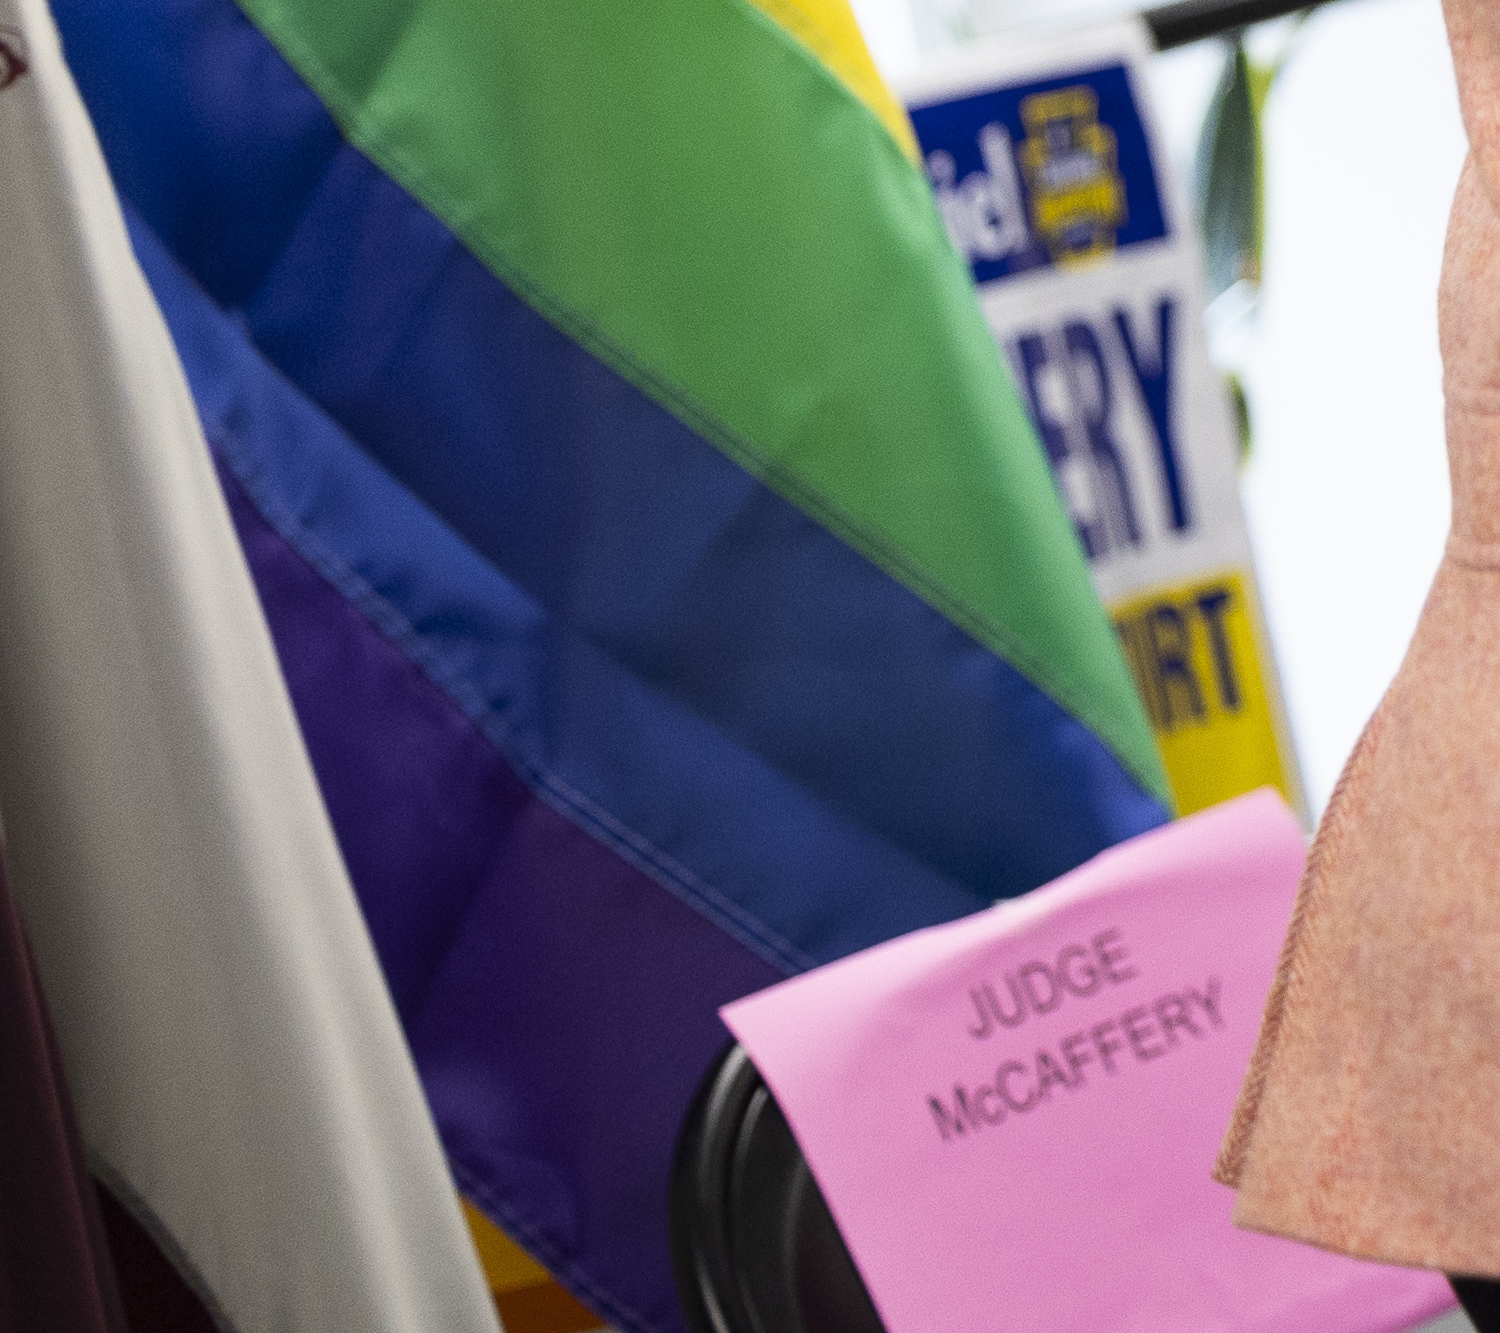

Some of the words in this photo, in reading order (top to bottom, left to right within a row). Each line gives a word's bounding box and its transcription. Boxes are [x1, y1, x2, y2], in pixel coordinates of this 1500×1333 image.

[1012, 291, 1194, 563] ERY
[926, 971, 1227, 1144] McCAFFERY
[968, 928, 1141, 1040] JUDGE
